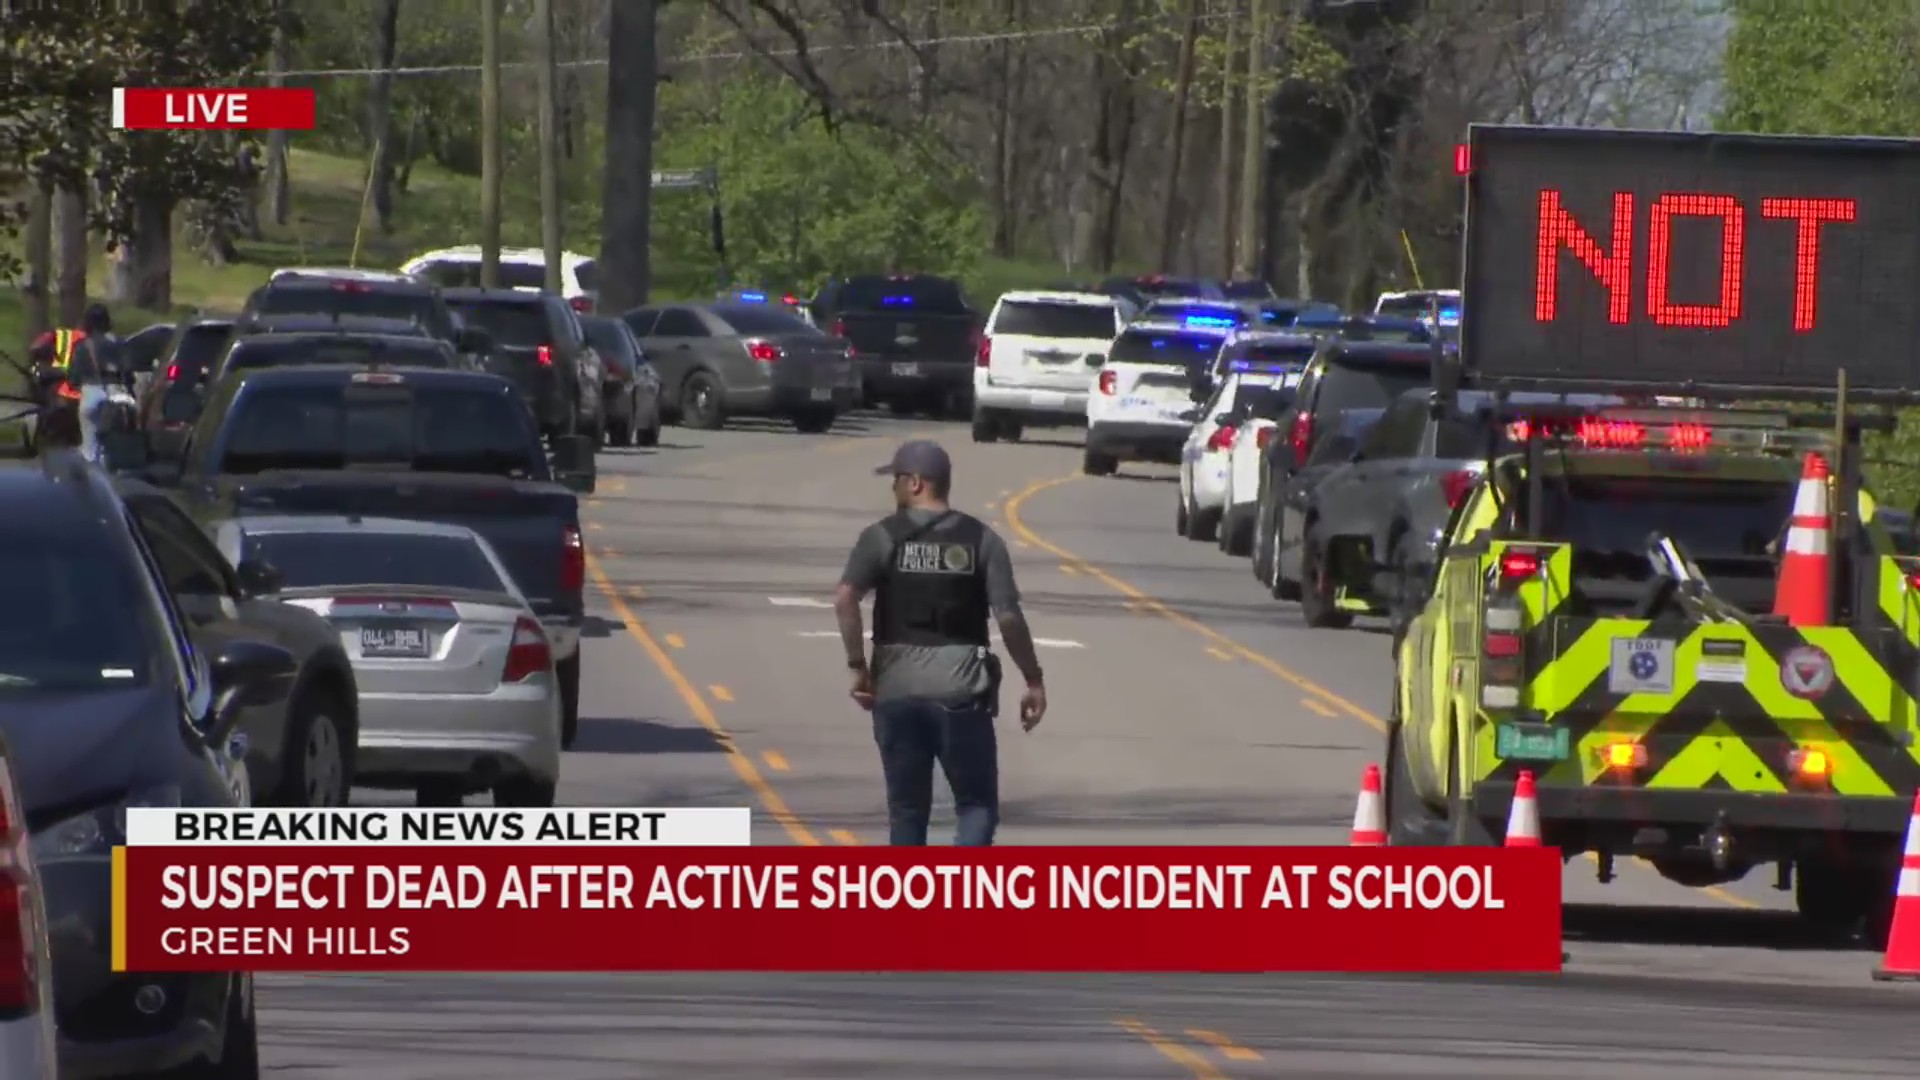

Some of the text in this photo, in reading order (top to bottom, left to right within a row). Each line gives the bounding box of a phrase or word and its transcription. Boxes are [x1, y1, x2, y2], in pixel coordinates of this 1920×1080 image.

[1535, 189, 1857, 332] NOT
[904, 543, 940, 556] METRO
[902, 556, 940, 570] POLICE
